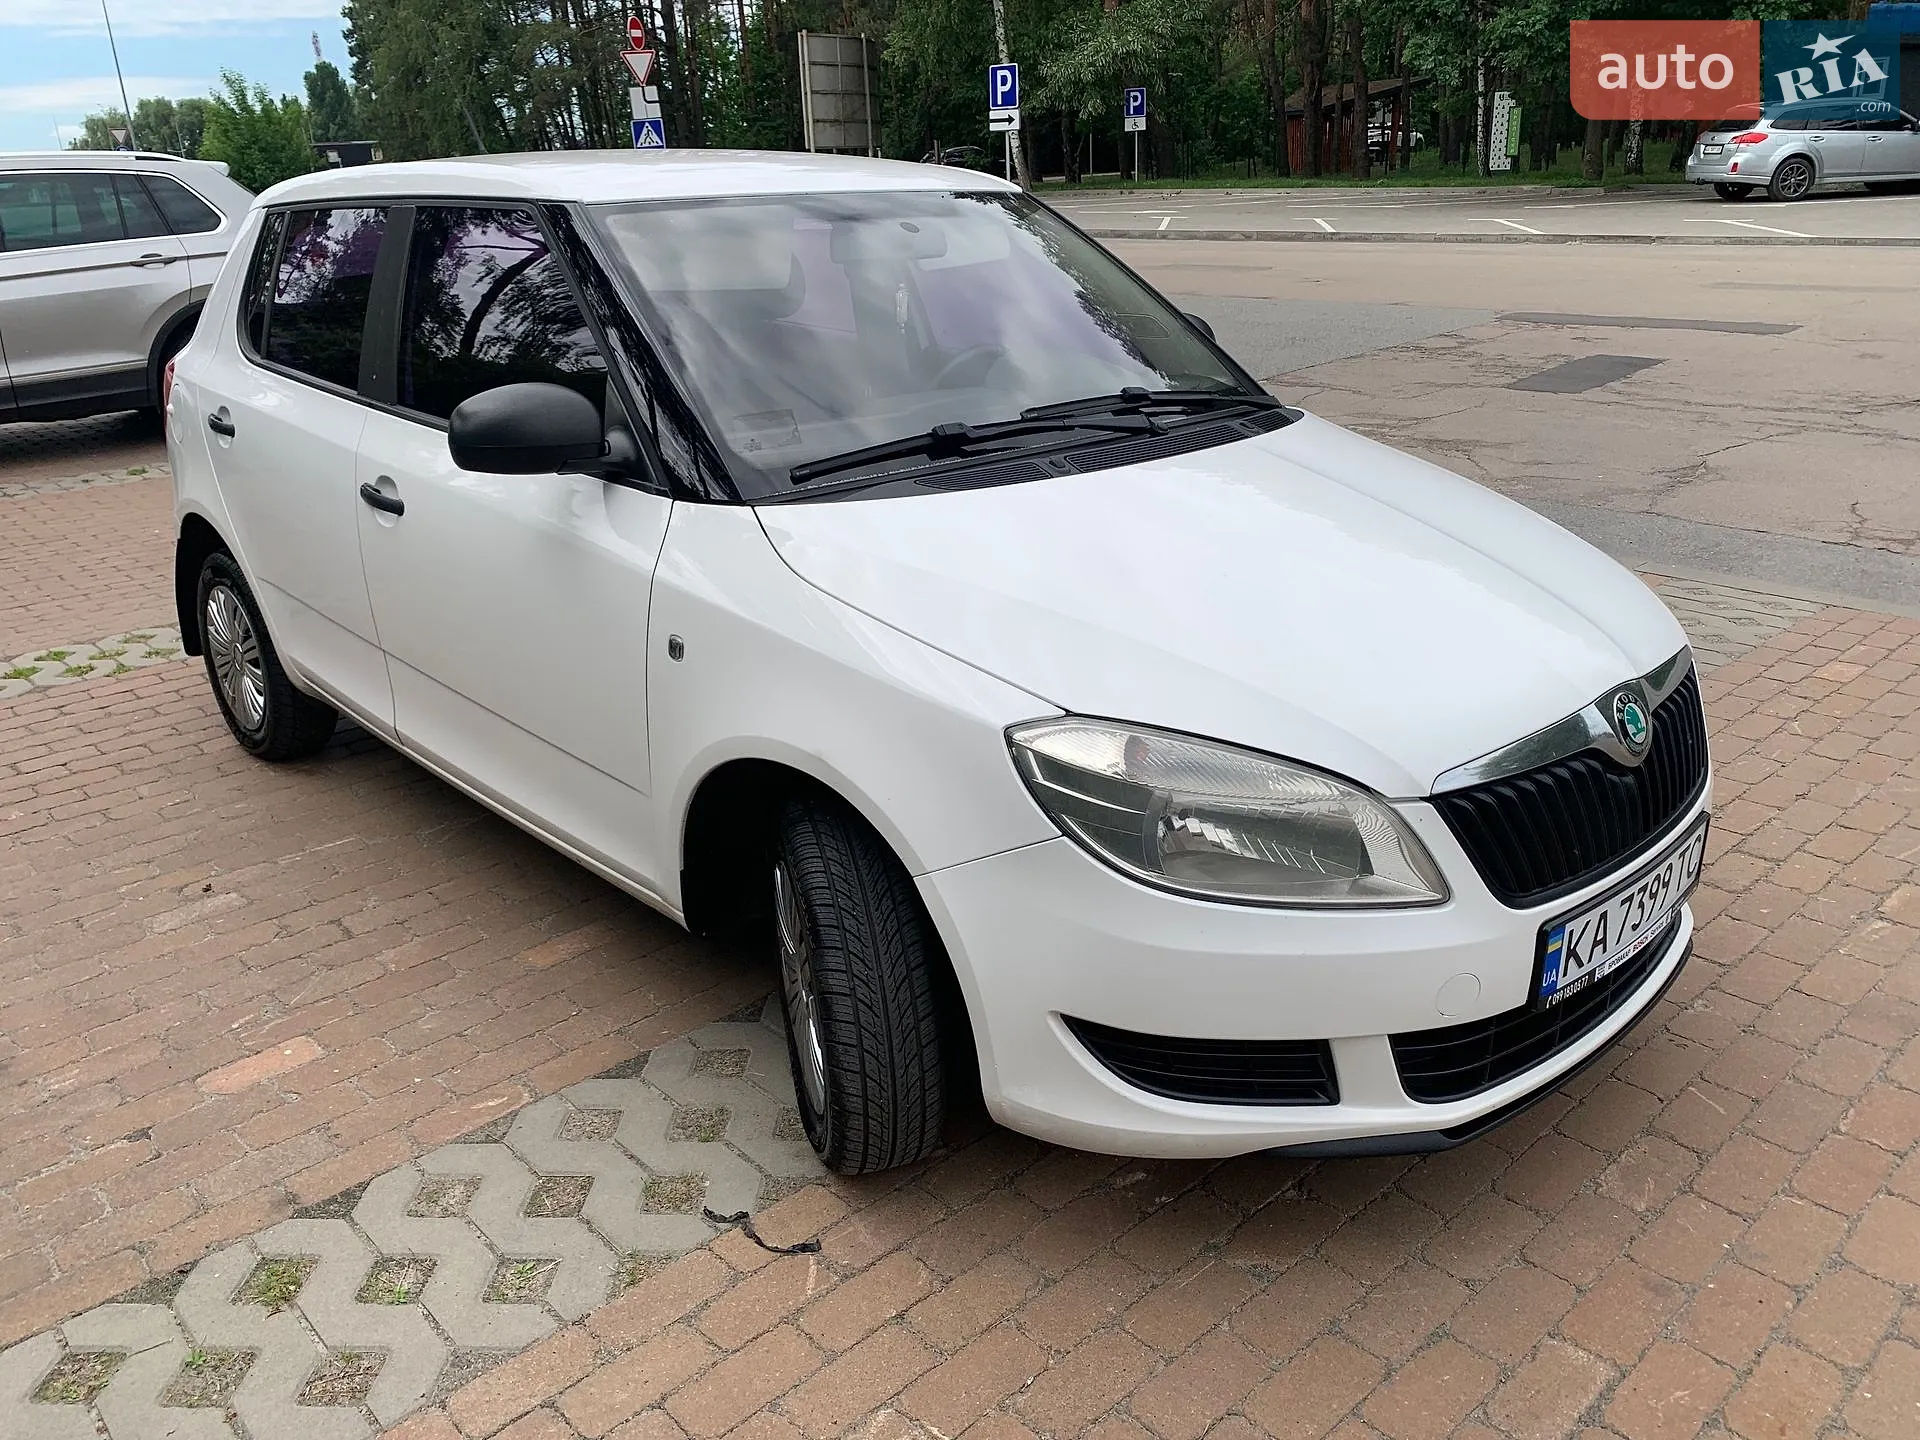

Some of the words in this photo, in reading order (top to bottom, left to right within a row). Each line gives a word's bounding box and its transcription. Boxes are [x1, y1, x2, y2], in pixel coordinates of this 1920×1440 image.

[996, 69, 1012, 105] P
[1129, 91, 1142, 115] P
[1563, 910, 1608, 978] KA
[1615, 862, 1674, 945] 7399
[1677, 833, 1702, 892] TC
[1542, 968, 1556, 987] UA
